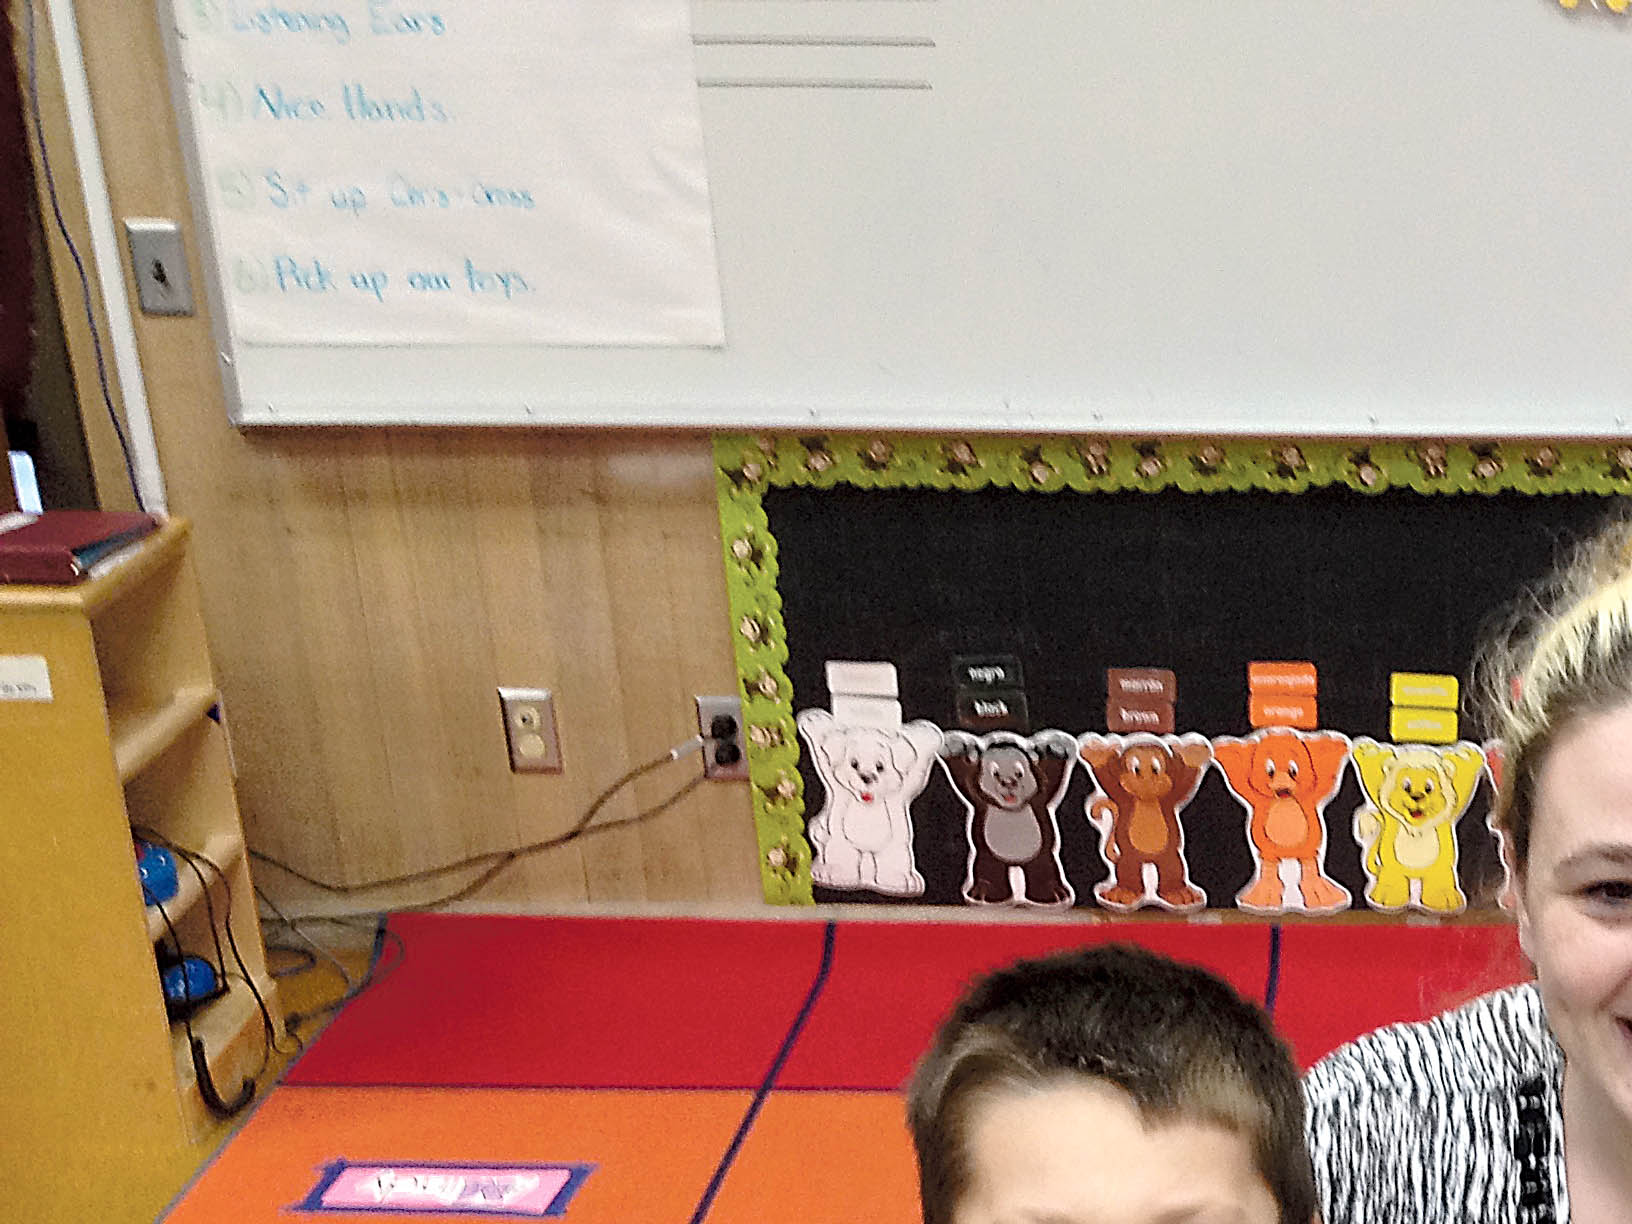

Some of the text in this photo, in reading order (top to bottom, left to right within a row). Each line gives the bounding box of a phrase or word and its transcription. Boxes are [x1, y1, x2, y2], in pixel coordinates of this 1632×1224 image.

[253, 82, 328, 121] Nice
[272, 255, 337, 292] Pick
[349, 271, 388, 303] up
